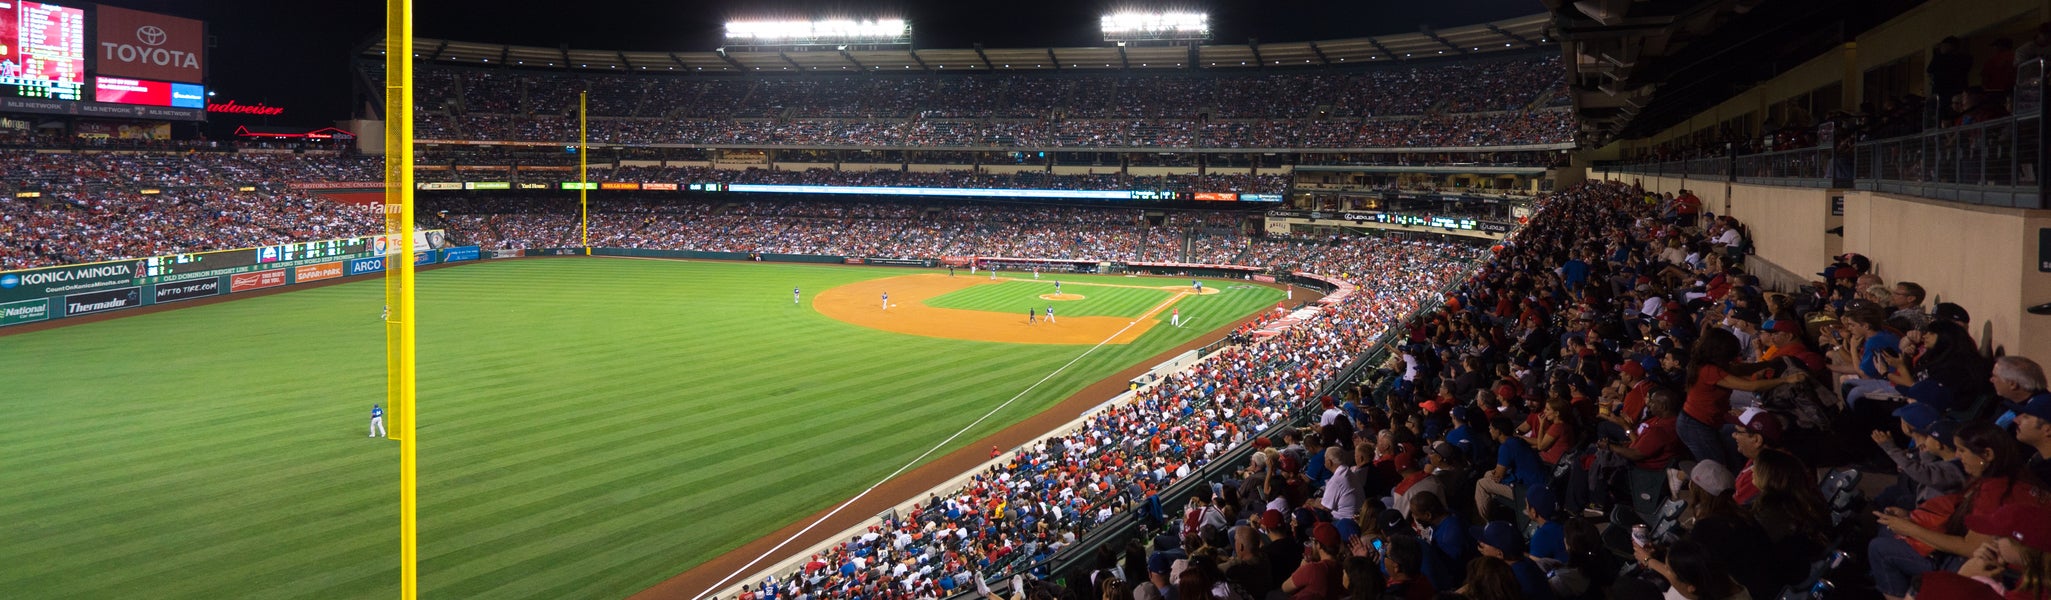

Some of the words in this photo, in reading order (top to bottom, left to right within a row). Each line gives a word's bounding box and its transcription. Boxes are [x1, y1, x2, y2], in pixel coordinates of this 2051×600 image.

[102, 42, 200, 69] TOYOTA
[25, 102, 62, 110] NETWORK
[99, 106, 130, 114] NETWORK
[207, 98, 284, 115] udweiser
[298, 270, 322, 280] SAFARI
[323, 267, 341, 276] PARK
[354, 260, 381, 272] ARCO
[21, 270, 74, 286] KONICA
[76, 264, 131, 280] MINOLTA
[163, 274, 177, 282] OLD
[178, 270, 210, 280] DOMINION
[210, 267, 235, 277] FREIGHT
[157, 287, 182, 297] NITTO
[183, 281, 217, 293] TIRE.COM
[5, 304, 46, 317] National
[68, 297, 127, 313] Thermador
